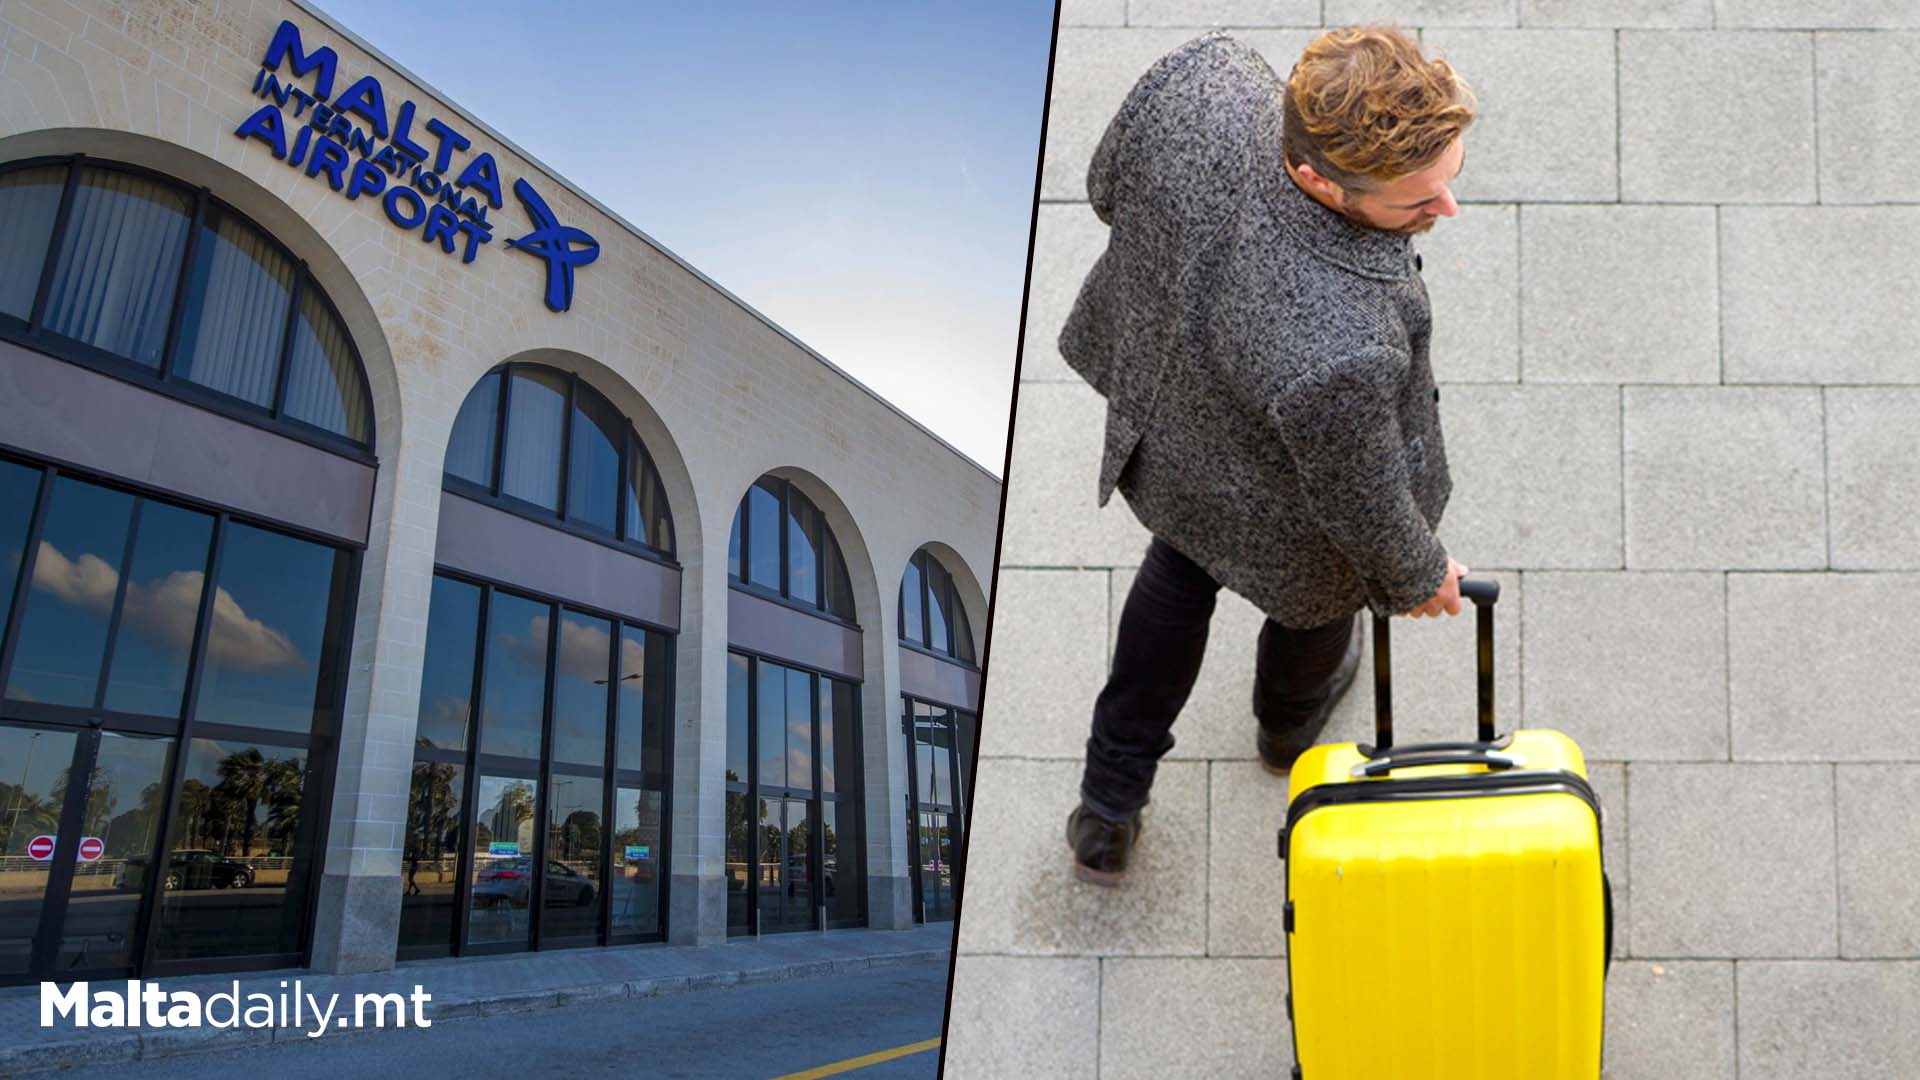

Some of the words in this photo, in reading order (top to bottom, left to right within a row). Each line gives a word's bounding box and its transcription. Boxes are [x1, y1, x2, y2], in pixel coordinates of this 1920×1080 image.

[234, 105, 493, 264] AIRPORT
[252, 69, 494, 231] INTERNATIONAL
[262, 20, 503, 209] MALTA
